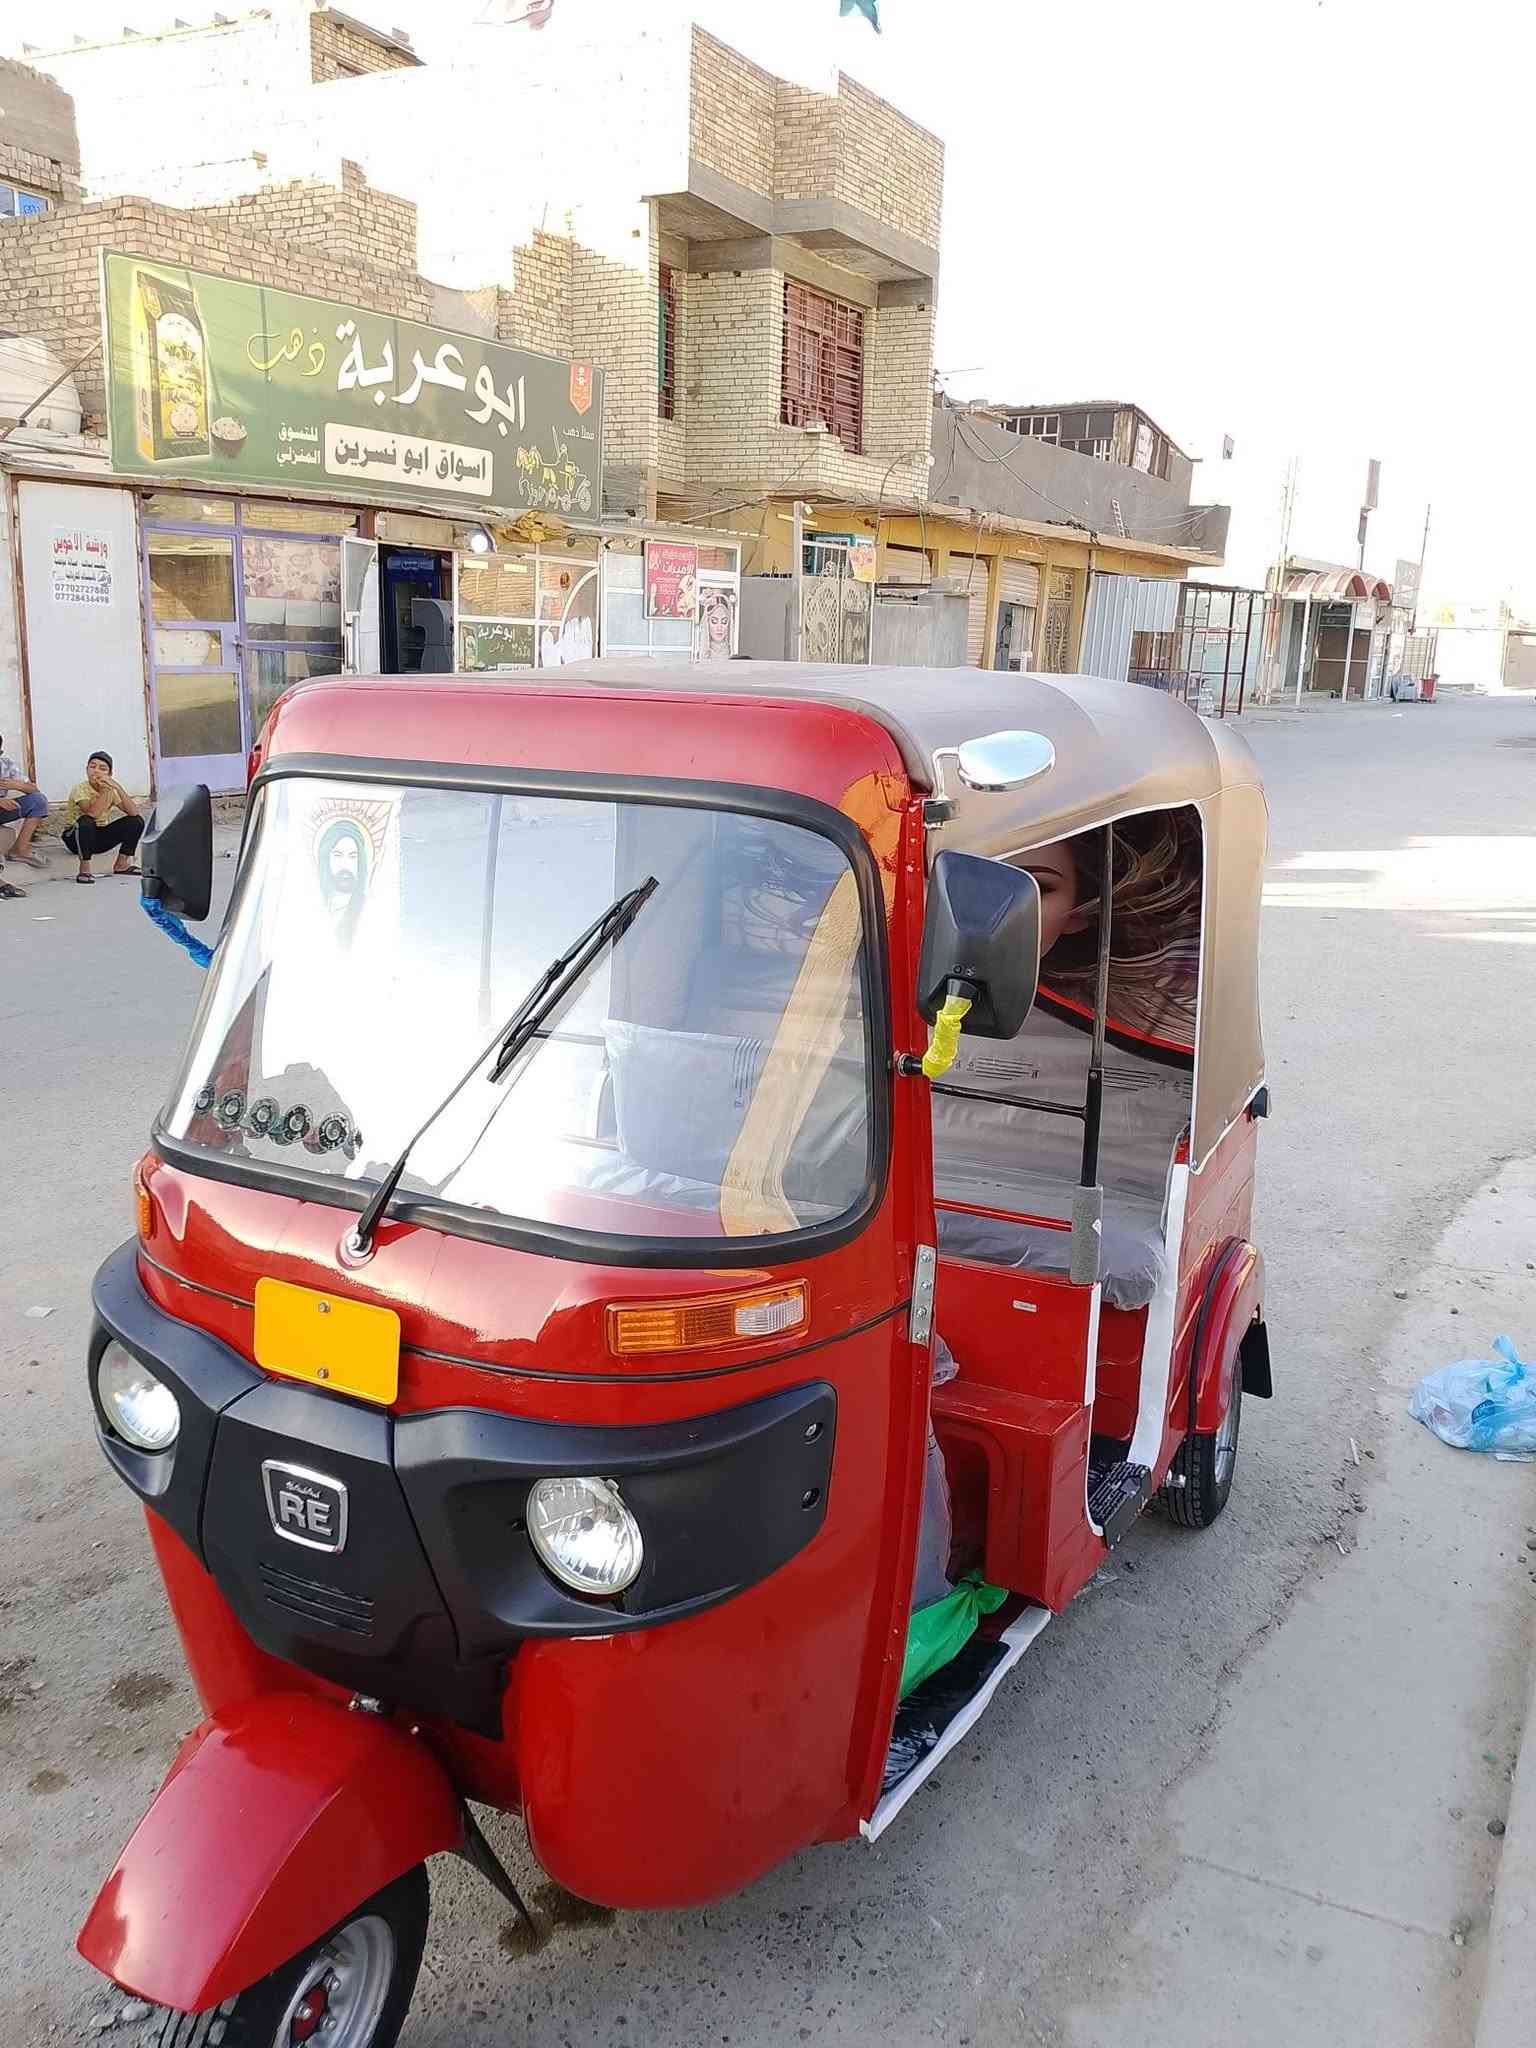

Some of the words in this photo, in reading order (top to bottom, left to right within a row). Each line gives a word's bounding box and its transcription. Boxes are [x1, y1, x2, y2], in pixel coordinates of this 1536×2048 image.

[247, 327, 326, 382] ذهب
[337, 320, 467, 406] عربة
[464, 365, 525, 436] ابو
[278, 422, 319, 442] للتسوق
[277, 446, 320, 467] المنزلي
[335, 439, 397, 467] نسرين
[402, 446, 429, 475] ابو
[435, 449, 486, 481] اسواق
[280, 1491, 332, 1536] RE
